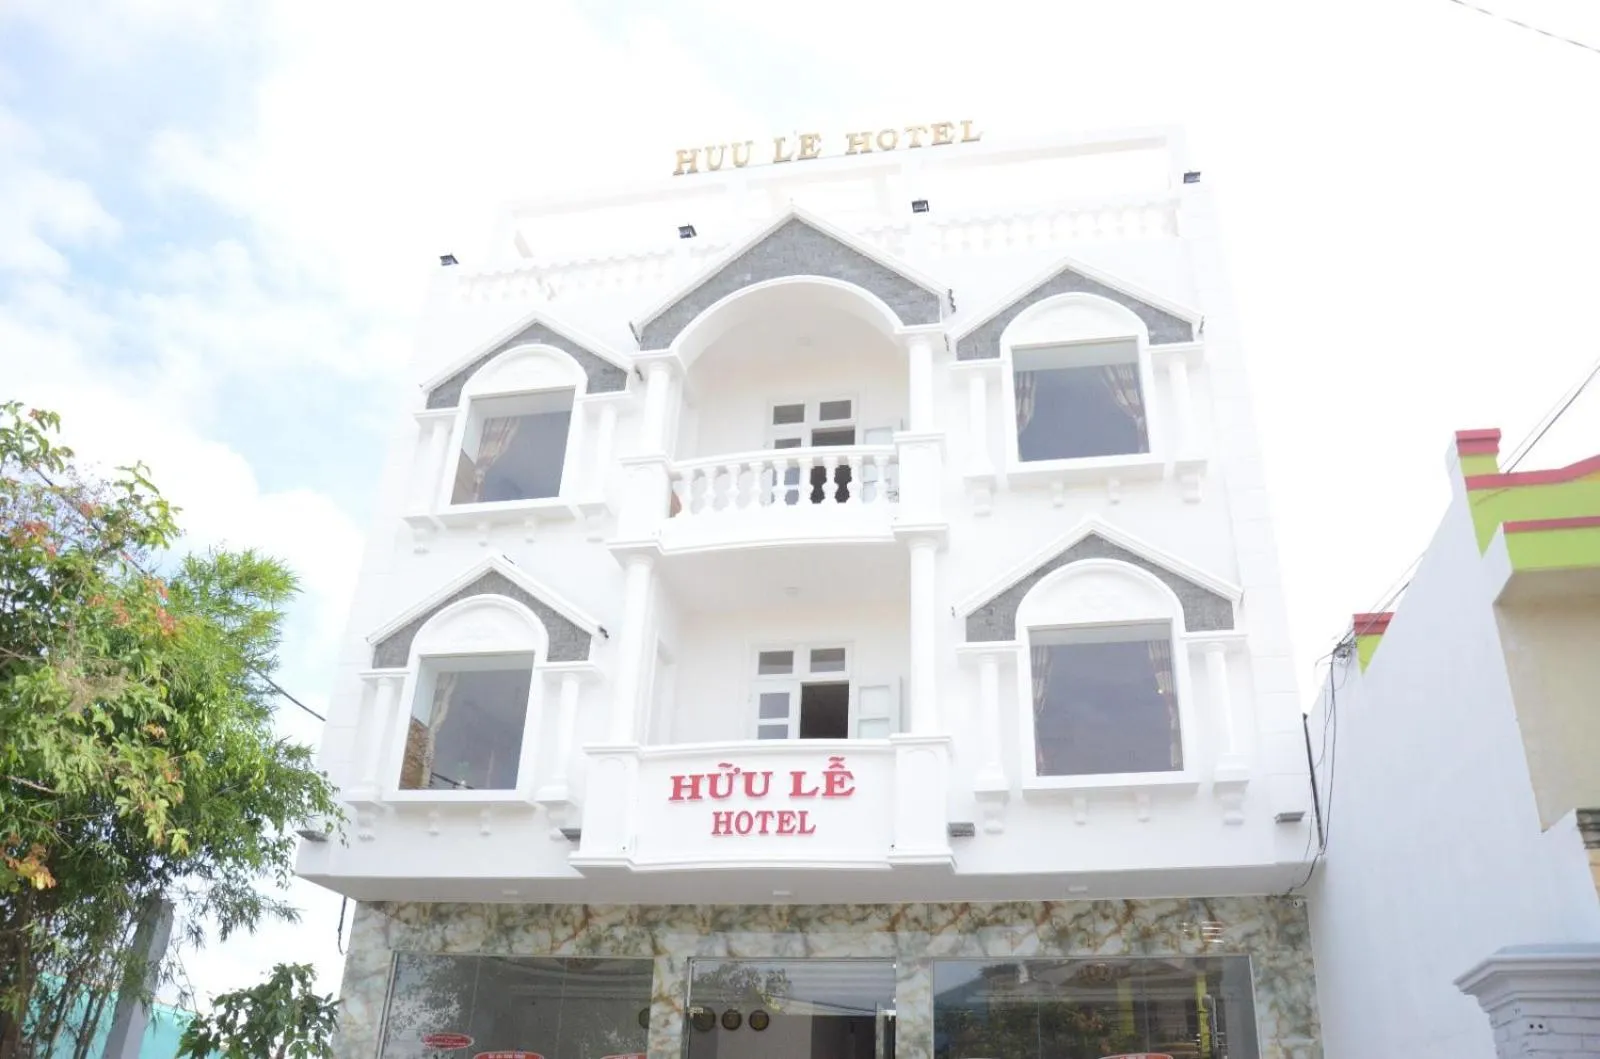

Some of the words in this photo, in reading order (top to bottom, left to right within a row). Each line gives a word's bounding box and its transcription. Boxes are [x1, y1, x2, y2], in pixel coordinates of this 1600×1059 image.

[845, 120, 983, 155] HOTEL
[669, 762, 773, 801] HỮU
[789, 756, 856, 798] LỄ
[712, 811, 816, 836] HOTEL
